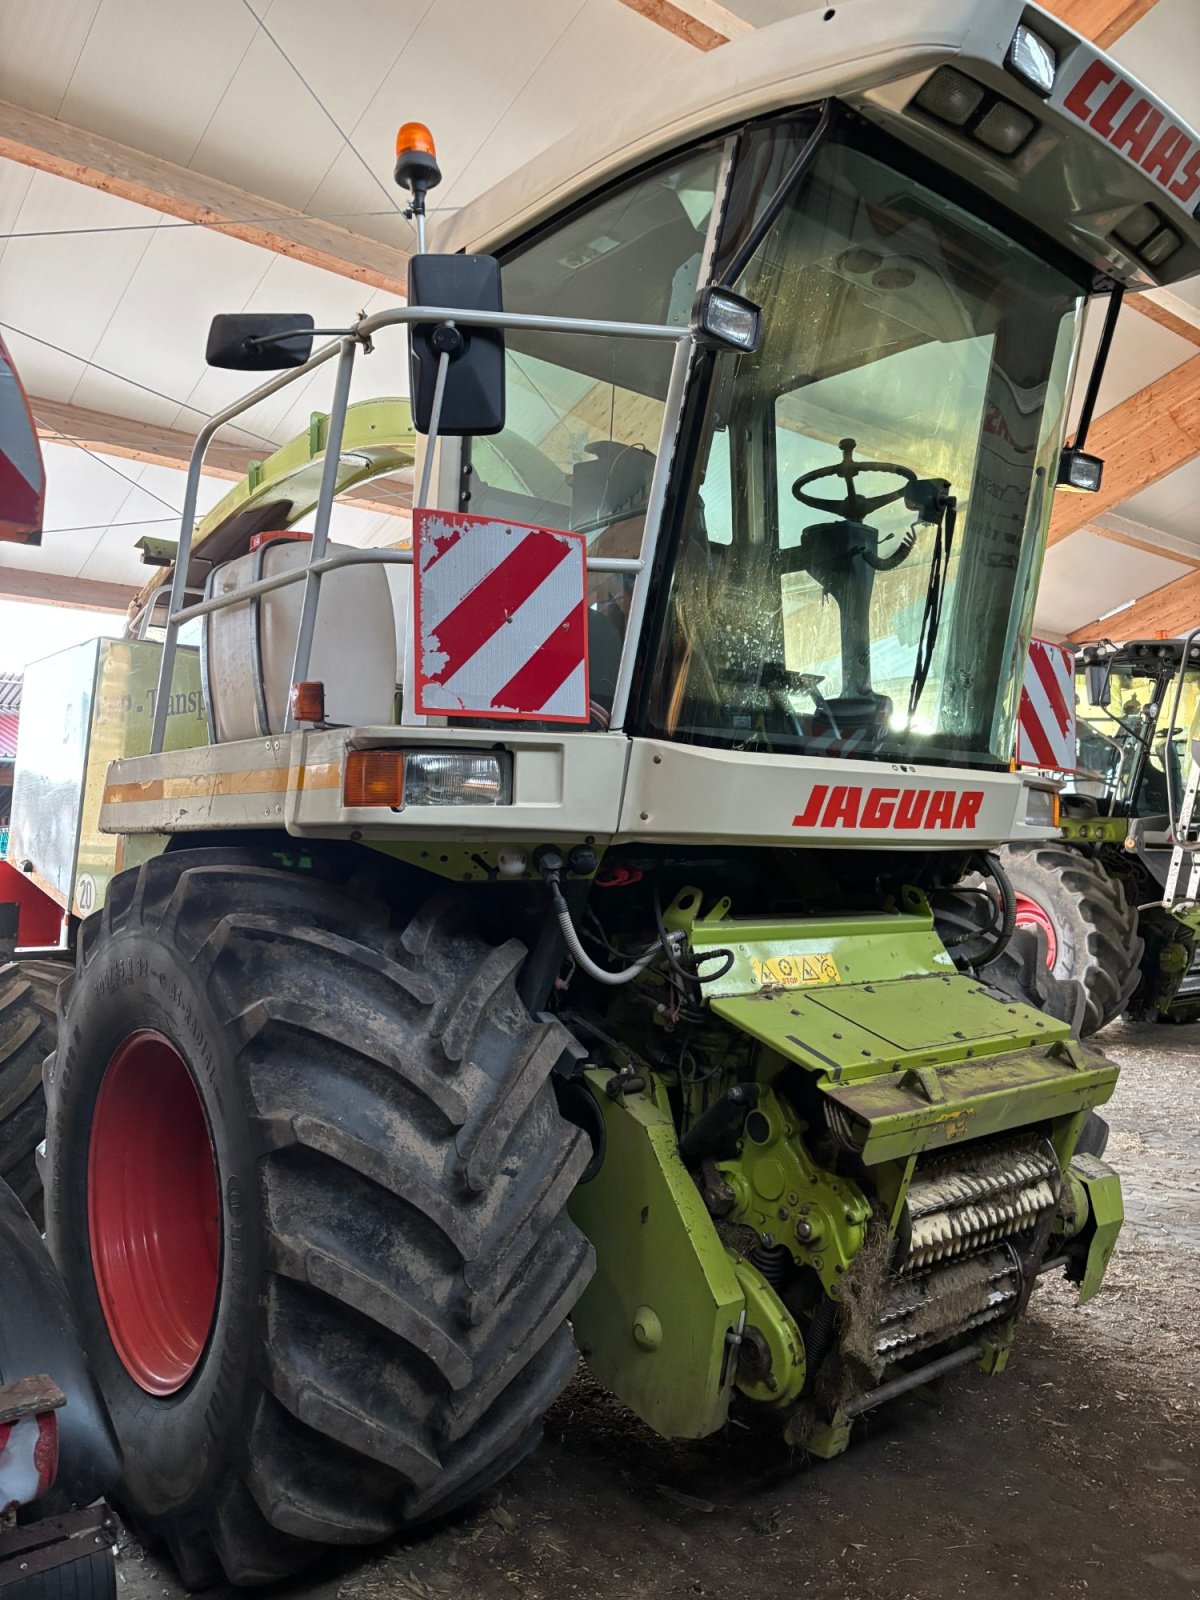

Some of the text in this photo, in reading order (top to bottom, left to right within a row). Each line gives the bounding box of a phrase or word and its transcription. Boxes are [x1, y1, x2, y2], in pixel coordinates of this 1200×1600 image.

[1063, 58, 1200, 203] CLAAS
[146, 688, 206, 721] Tansp
[791, 784, 985, 829] JAGUAR
[79, 879, 92, 910] 20
[781, 976, 799, 985] STOP
